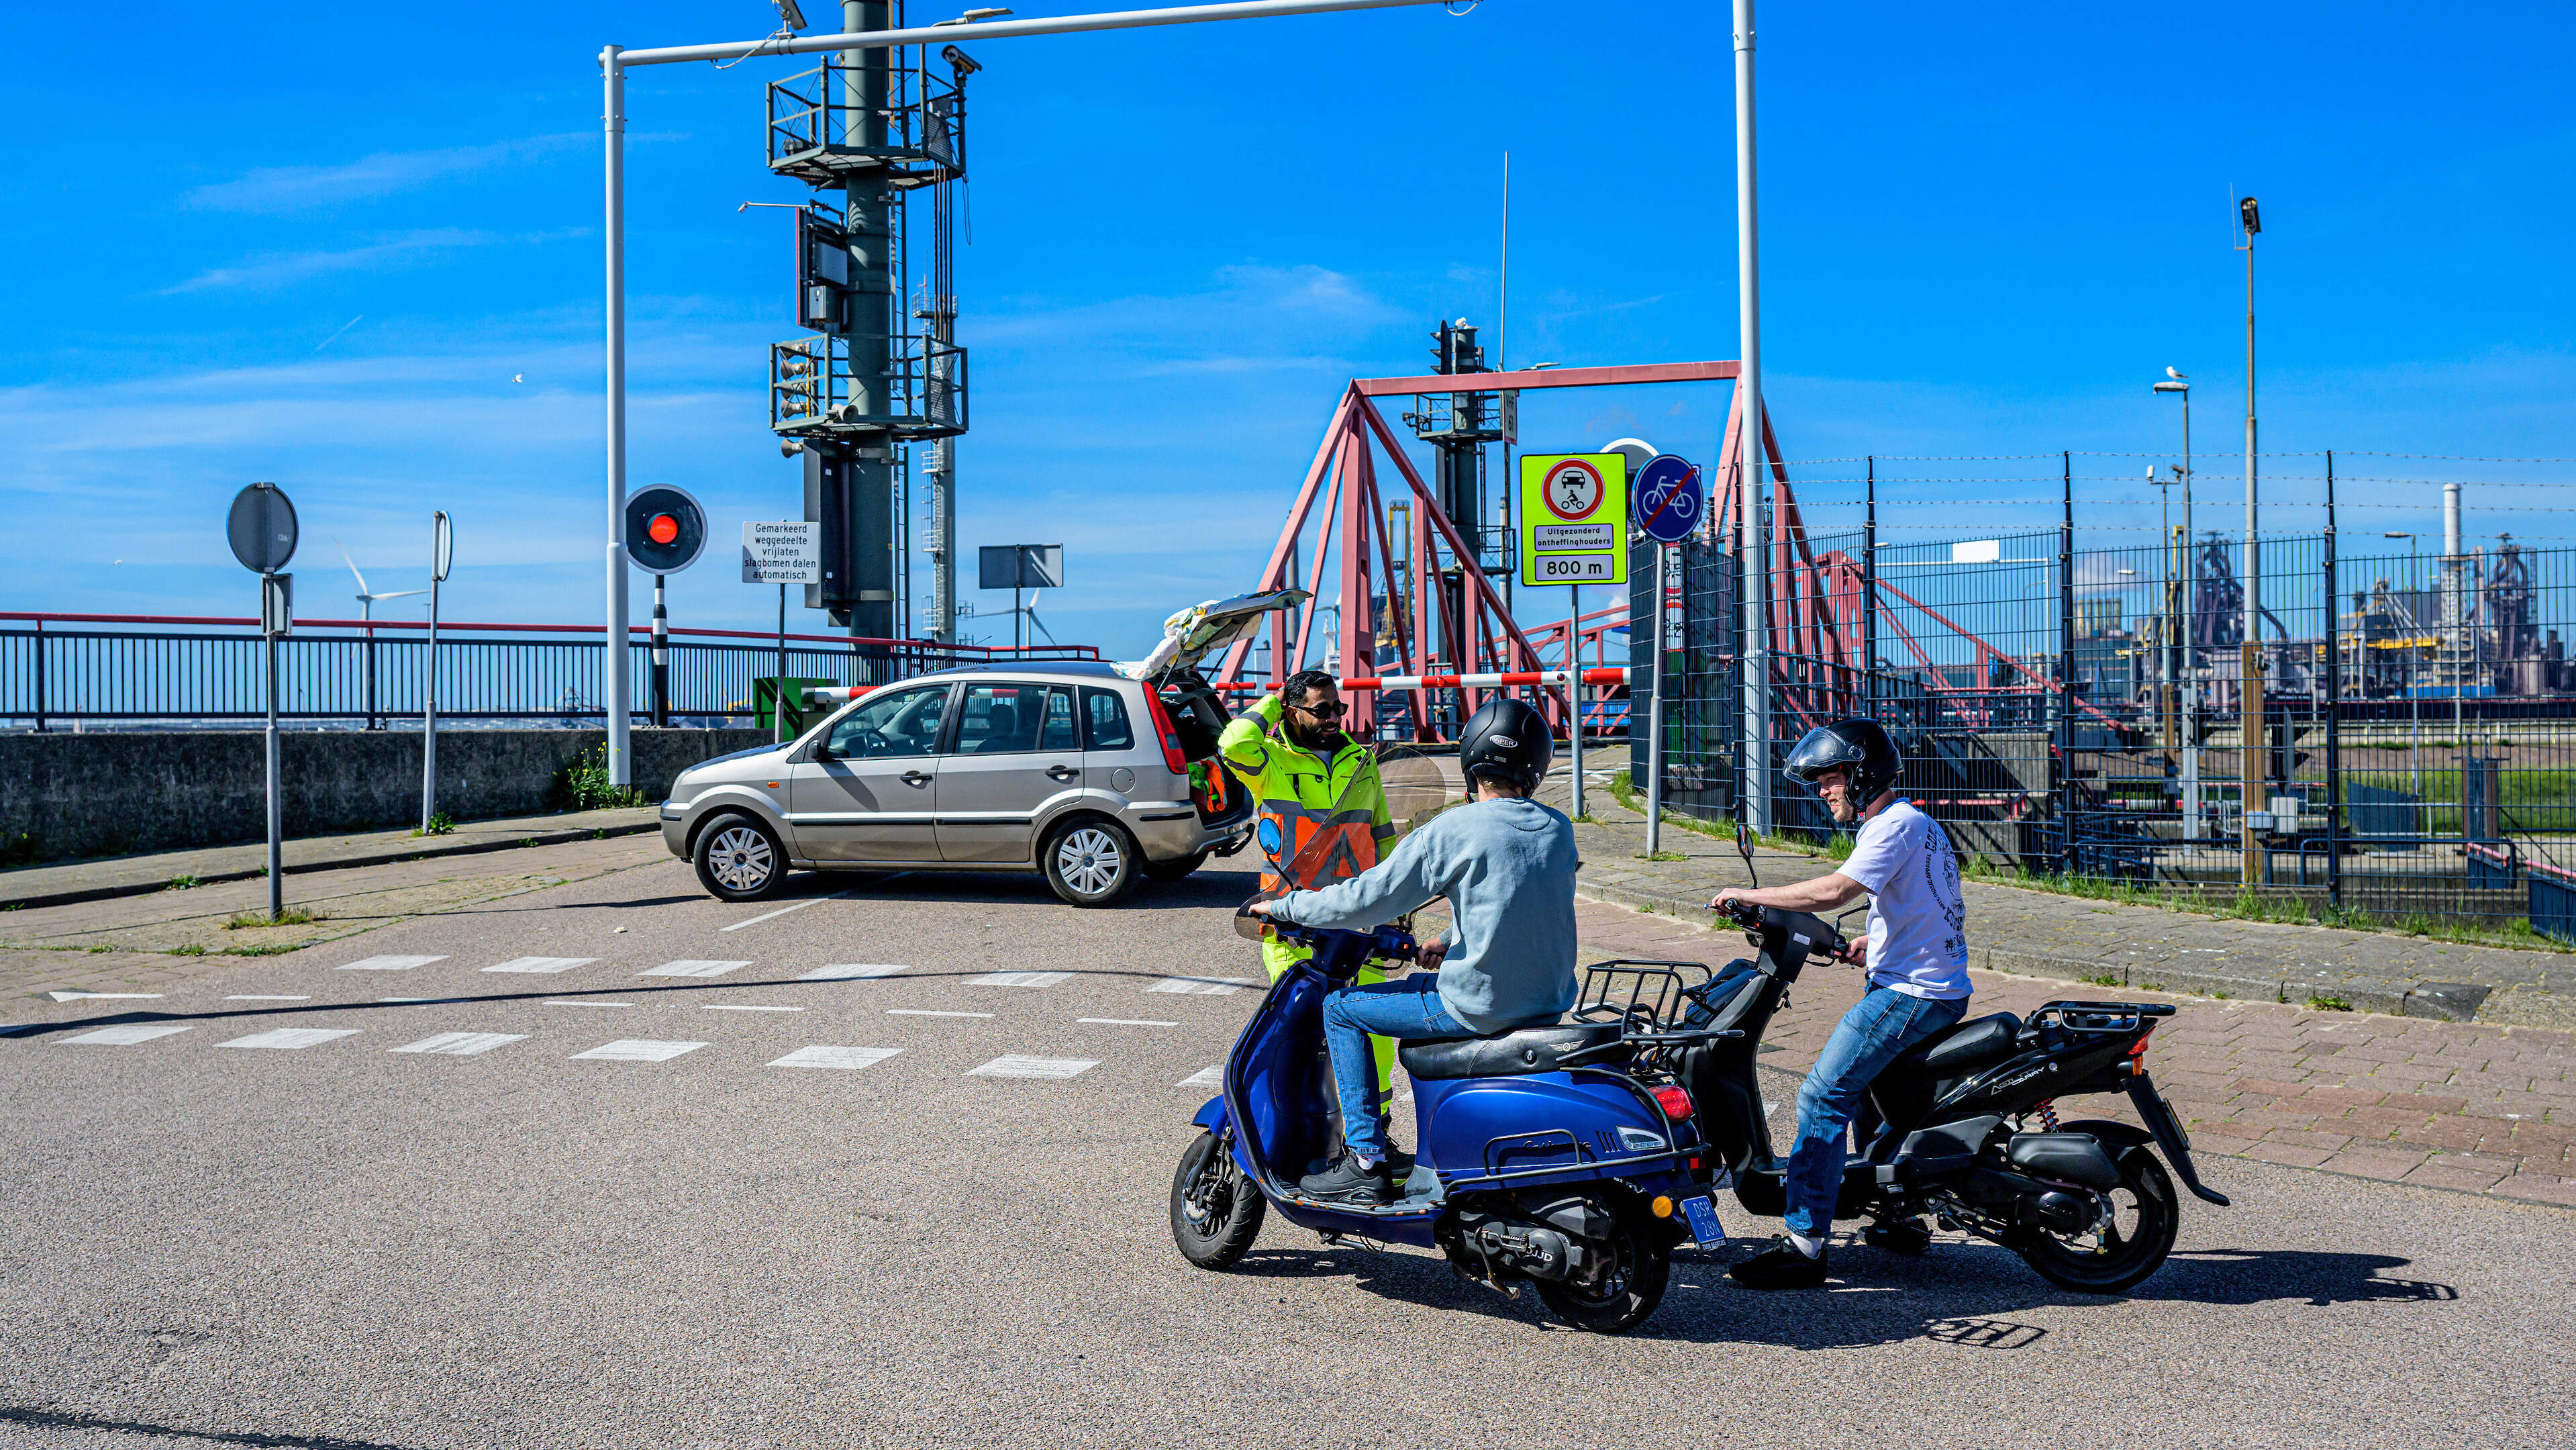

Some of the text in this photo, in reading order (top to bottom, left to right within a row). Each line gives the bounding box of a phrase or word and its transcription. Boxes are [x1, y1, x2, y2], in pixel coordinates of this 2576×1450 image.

[1508, 414, 1514, 432] 61
[756, 524, 807, 533] Gemarkeerd
[1547, 527, 1600, 536] Uitgezonderd
[755, 536, 807, 547] weggedeelte
[1538, 538, 1611, 547] ontheffinghouders
[762, 547, 799, 559] vrijlaten
[744, 558, 816, 569] slagbomen dalen
[1546, 561, 1602, 575] 800 m
[753, 570, 807, 579] automatisch
[2012, 1066, 2045, 1085] CARRY
[1701, 1220, 1721, 1237] 28N
